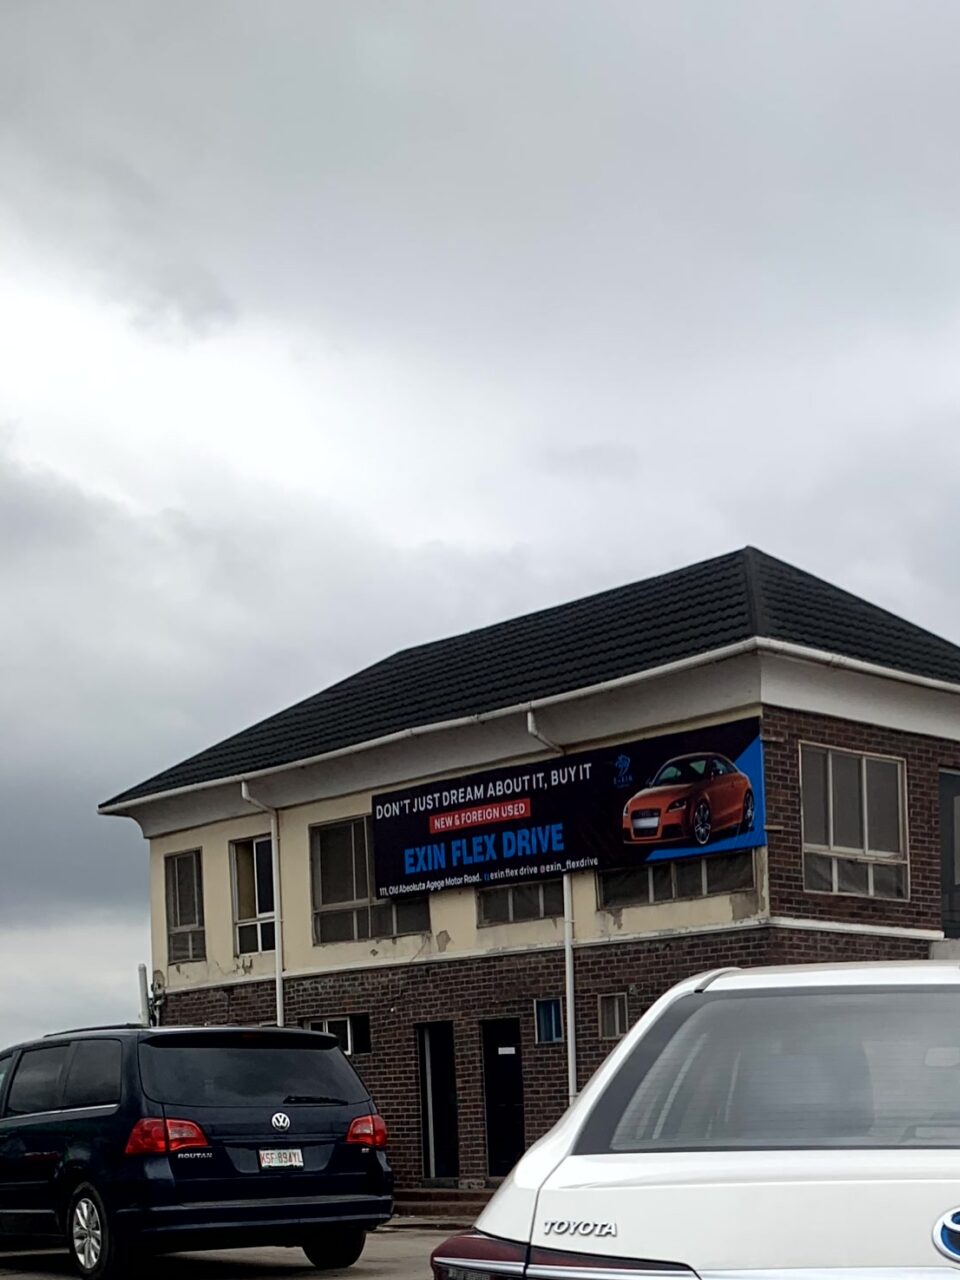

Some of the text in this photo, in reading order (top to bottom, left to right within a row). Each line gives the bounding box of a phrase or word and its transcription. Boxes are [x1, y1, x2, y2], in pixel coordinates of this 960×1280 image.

[376, 799, 411, 819] DON'T
[412, 792, 440, 812] JUST
[442, 784, 484, 806] DREAM
[487, 775, 530, 798] ABOUT
[532, 772, 548, 790] IT,
[551, 765, 577, 786] BUY
[579, 763, 592, 780] IT
[434, 802, 526, 830] NEW & FOREIGN USED
[404, 823, 564, 875] EXIN FLEX DRIVE
[389, 884, 399, 895] Old
[426, 879, 445, 891] Agege
[445, 874, 464, 886] Motor
[519, 865, 538, 875] drive
[544, 1220, 618, 1237] TOYOTA
